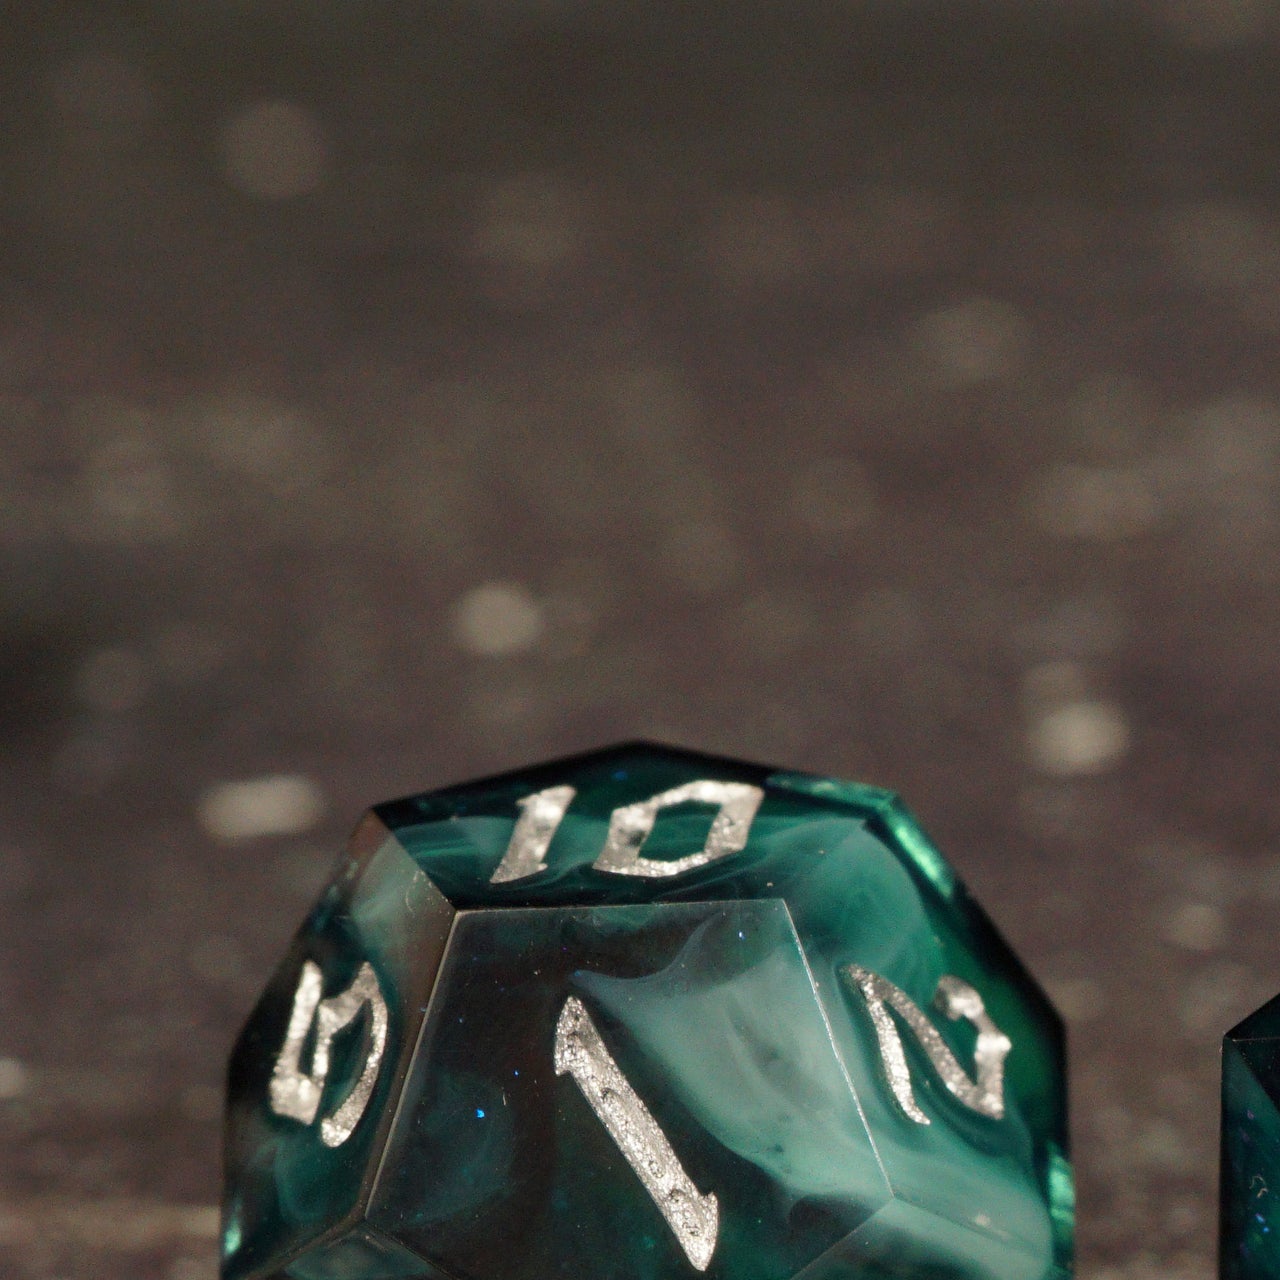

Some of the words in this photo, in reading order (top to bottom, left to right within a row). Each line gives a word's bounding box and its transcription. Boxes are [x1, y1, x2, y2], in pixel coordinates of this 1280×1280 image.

[489, 780, 764, 884] 10
[840, 962, 1011, 1126] 2
[553, 996, 719, 1272] 1
